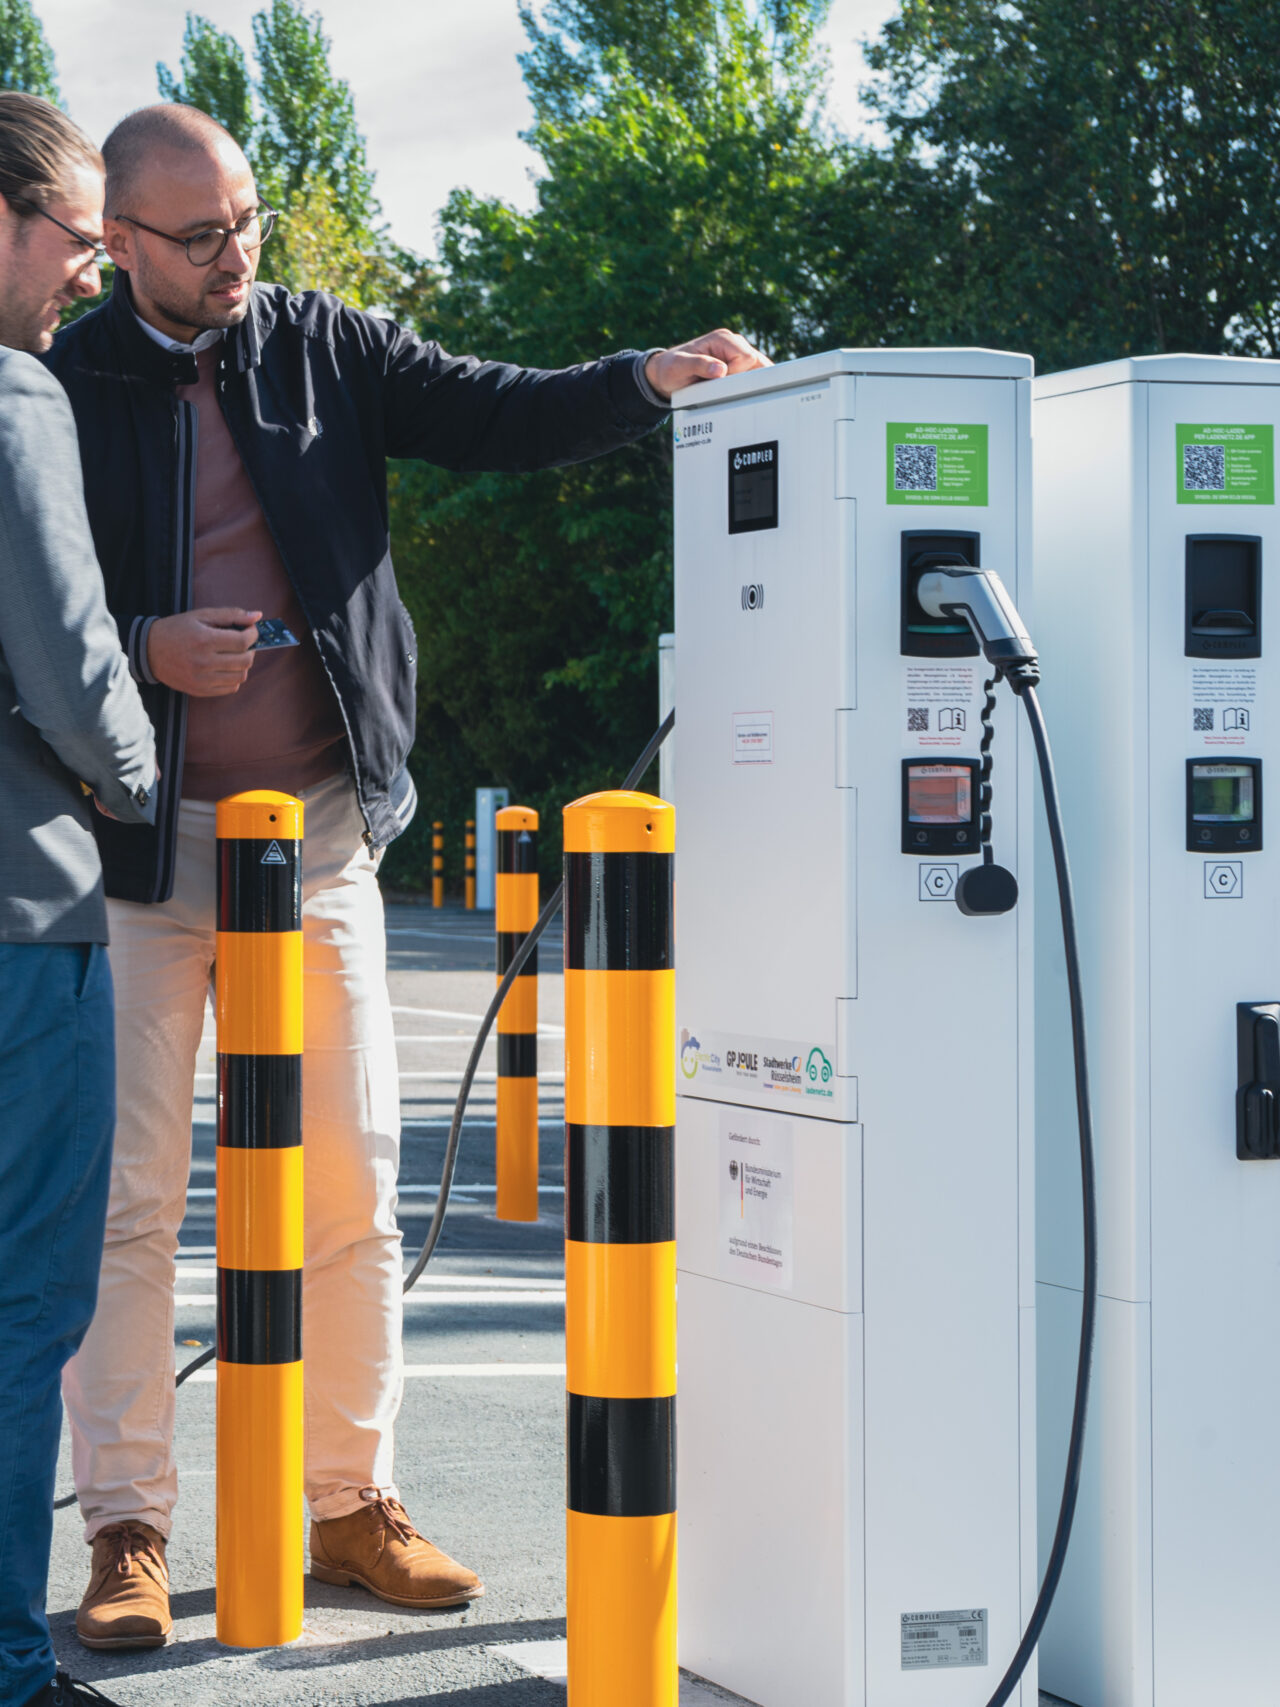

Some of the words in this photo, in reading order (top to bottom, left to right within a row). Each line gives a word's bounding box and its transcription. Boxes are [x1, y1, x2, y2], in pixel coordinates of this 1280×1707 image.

[683, 421, 713, 438] COMPLEO
[742, 449, 773, 466] COMPLEO
[934, 876, 944, 888] C
[1218, 874, 1228, 886] C
[726, 1050, 736, 1068] GP
[736, 1051, 758, 1071] JOULE
[763, 1056, 792, 1070] Stadtwerke
[771, 1070, 802, 1084] Rüsselsheim
[806, 1087, 833, 1097] ladenetz.de
[751, 1176, 771, 1188] Wirtschaft
[745, 1188, 753, 1196] und
[753, 1188, 768, 1200] Energie
[910, 1613, 940, 1622] COMPLEO
